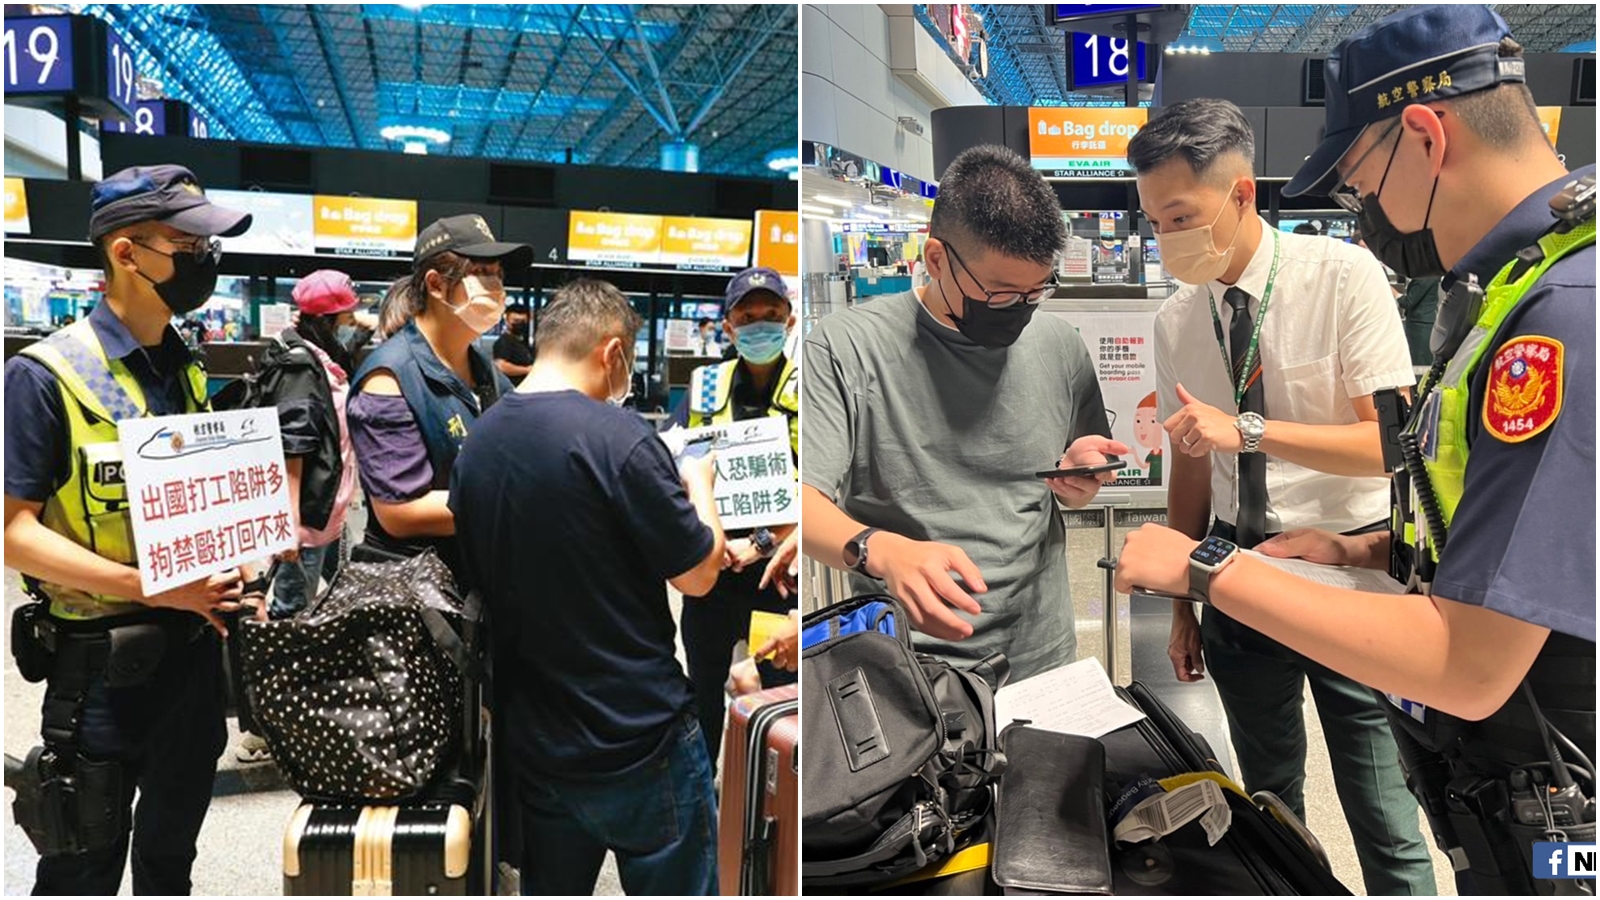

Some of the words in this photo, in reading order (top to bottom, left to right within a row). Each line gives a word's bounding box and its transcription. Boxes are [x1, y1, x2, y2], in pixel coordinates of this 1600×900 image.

[4, 26, 60, 85] 19
[1085, 34, 1129, 77] 18
[112, 44, 134, 105] 19
[1376, 70, 1452, 109] 航空警察局
[1063, 121, 1095, 139] Bag
[1098, 120, 1138, 140] drop
[343, 207, 372, 224] Bag
[597, 224, 623, 240] Bag
[548, 248, 558, 261] 4
[1503, 418, 1534, 432] 1454
[141, 461, 284, 522] 出國打工陷阱多
[715, 488, 792, 517] 工陷阱多
[1126, 511, 1167, 522] Taiwan
[148, 510, 292, 582] 拘禁毆打回不來
